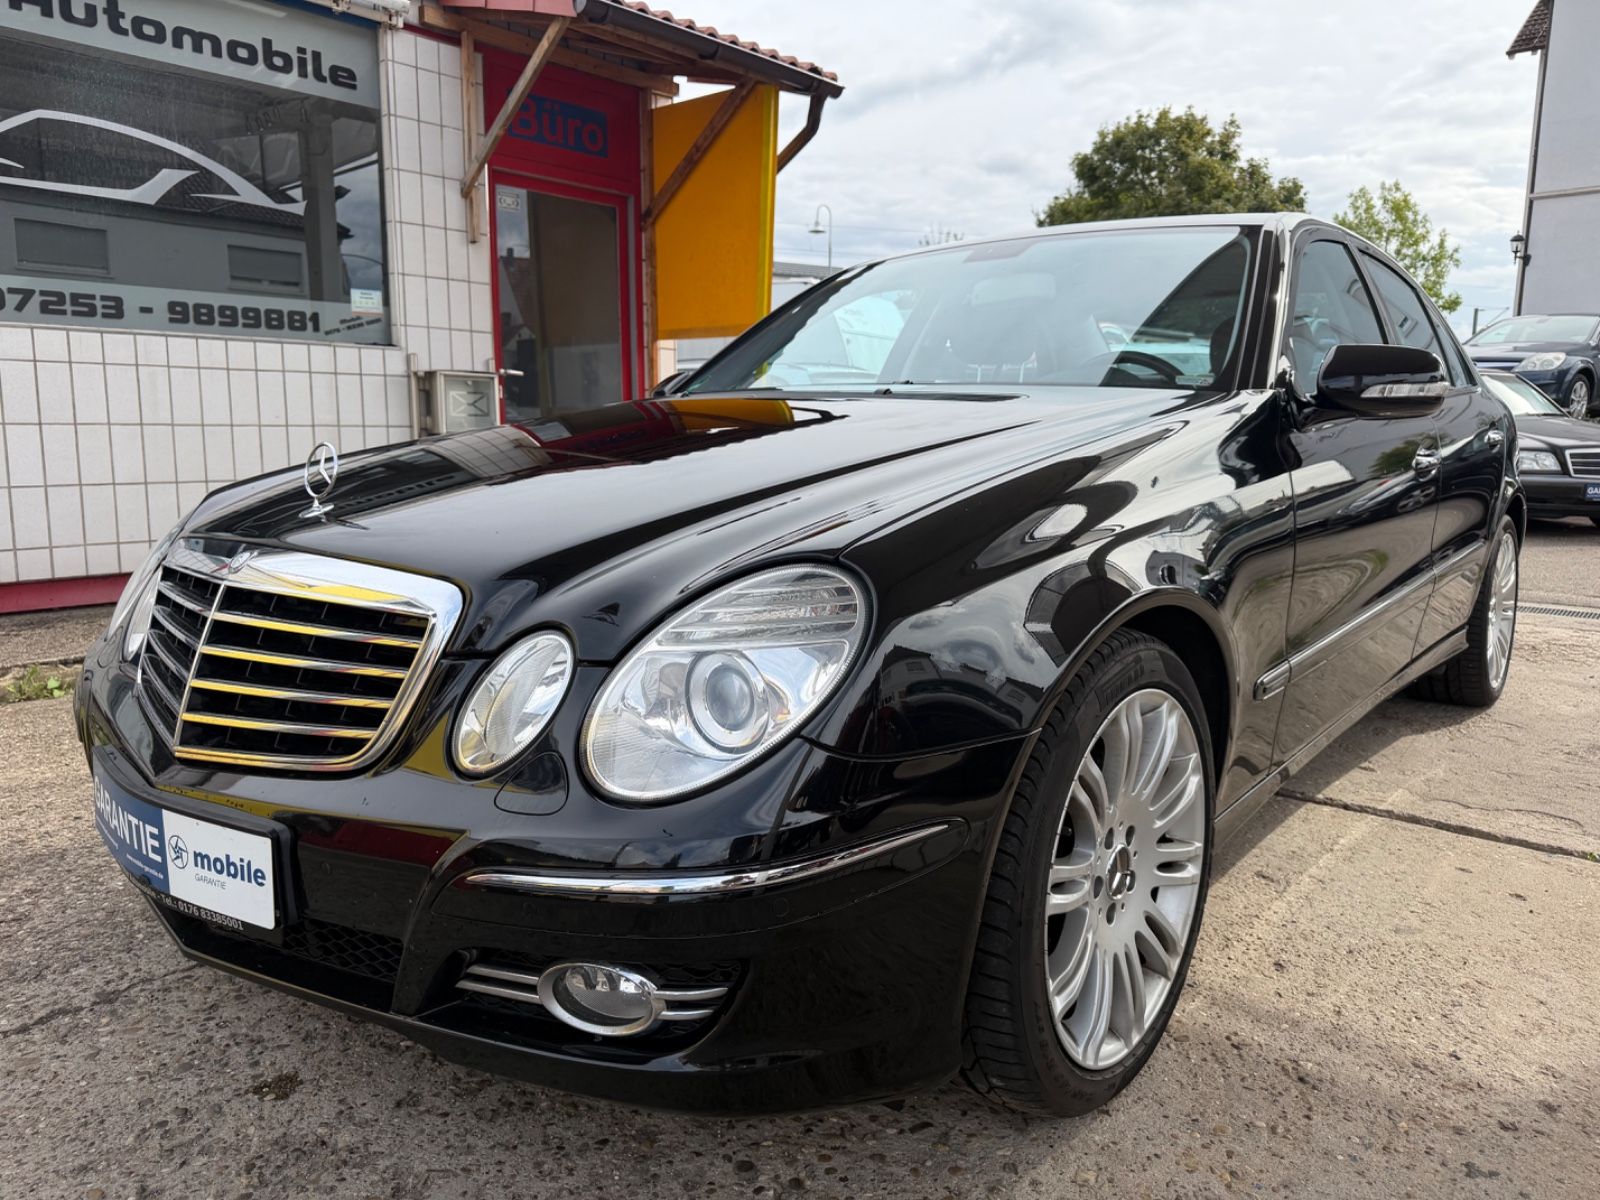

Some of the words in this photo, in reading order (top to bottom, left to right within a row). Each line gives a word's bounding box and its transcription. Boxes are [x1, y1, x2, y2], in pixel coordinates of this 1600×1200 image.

[511, 97, 604, 153] Büro
[0, 286, 125, 320] 7253
[167, 300, 321, 333] 9899881
[94, 775, 162, 863] GARANTIE
[193, 850, 267, 887] mobile
[194, 873, 227, 890] GARANTIE
[178, 900, 199, 916] 0176
